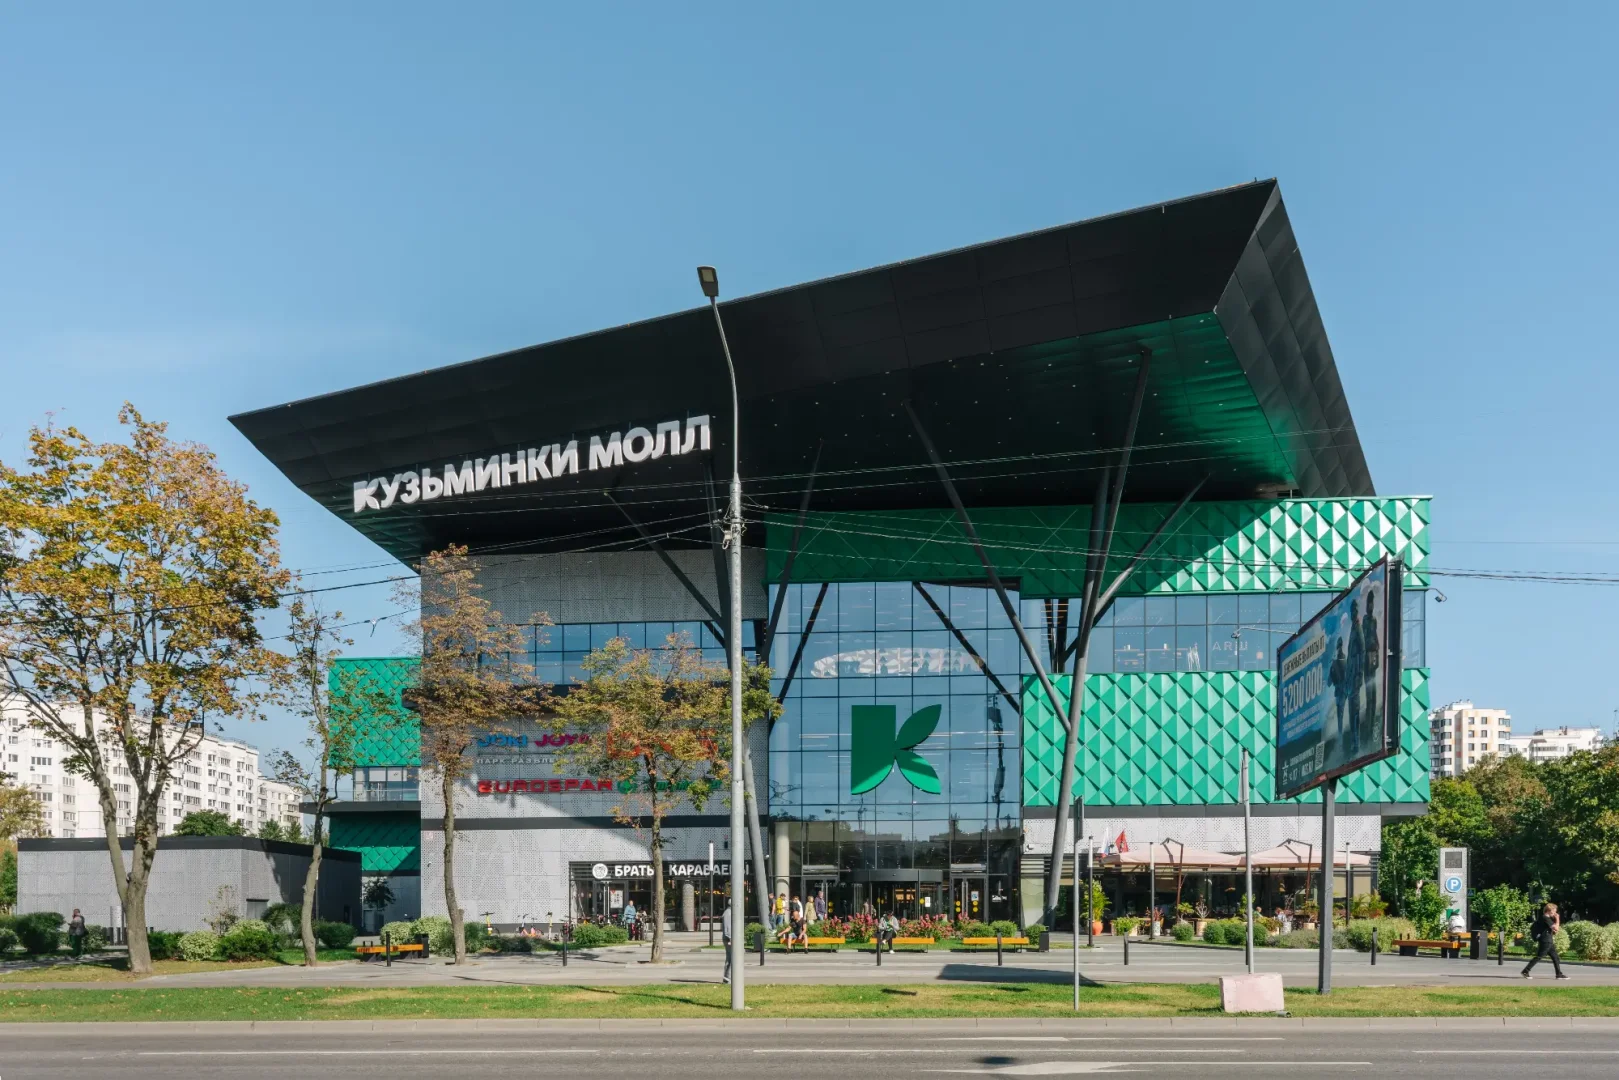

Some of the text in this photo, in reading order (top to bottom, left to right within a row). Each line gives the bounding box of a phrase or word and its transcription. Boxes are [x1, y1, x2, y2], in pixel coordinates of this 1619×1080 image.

[353, 414, 711, 512] КУЗЬМИНКИ МОЛЛ
[477, 779, 612, 793] EUROSPAR
